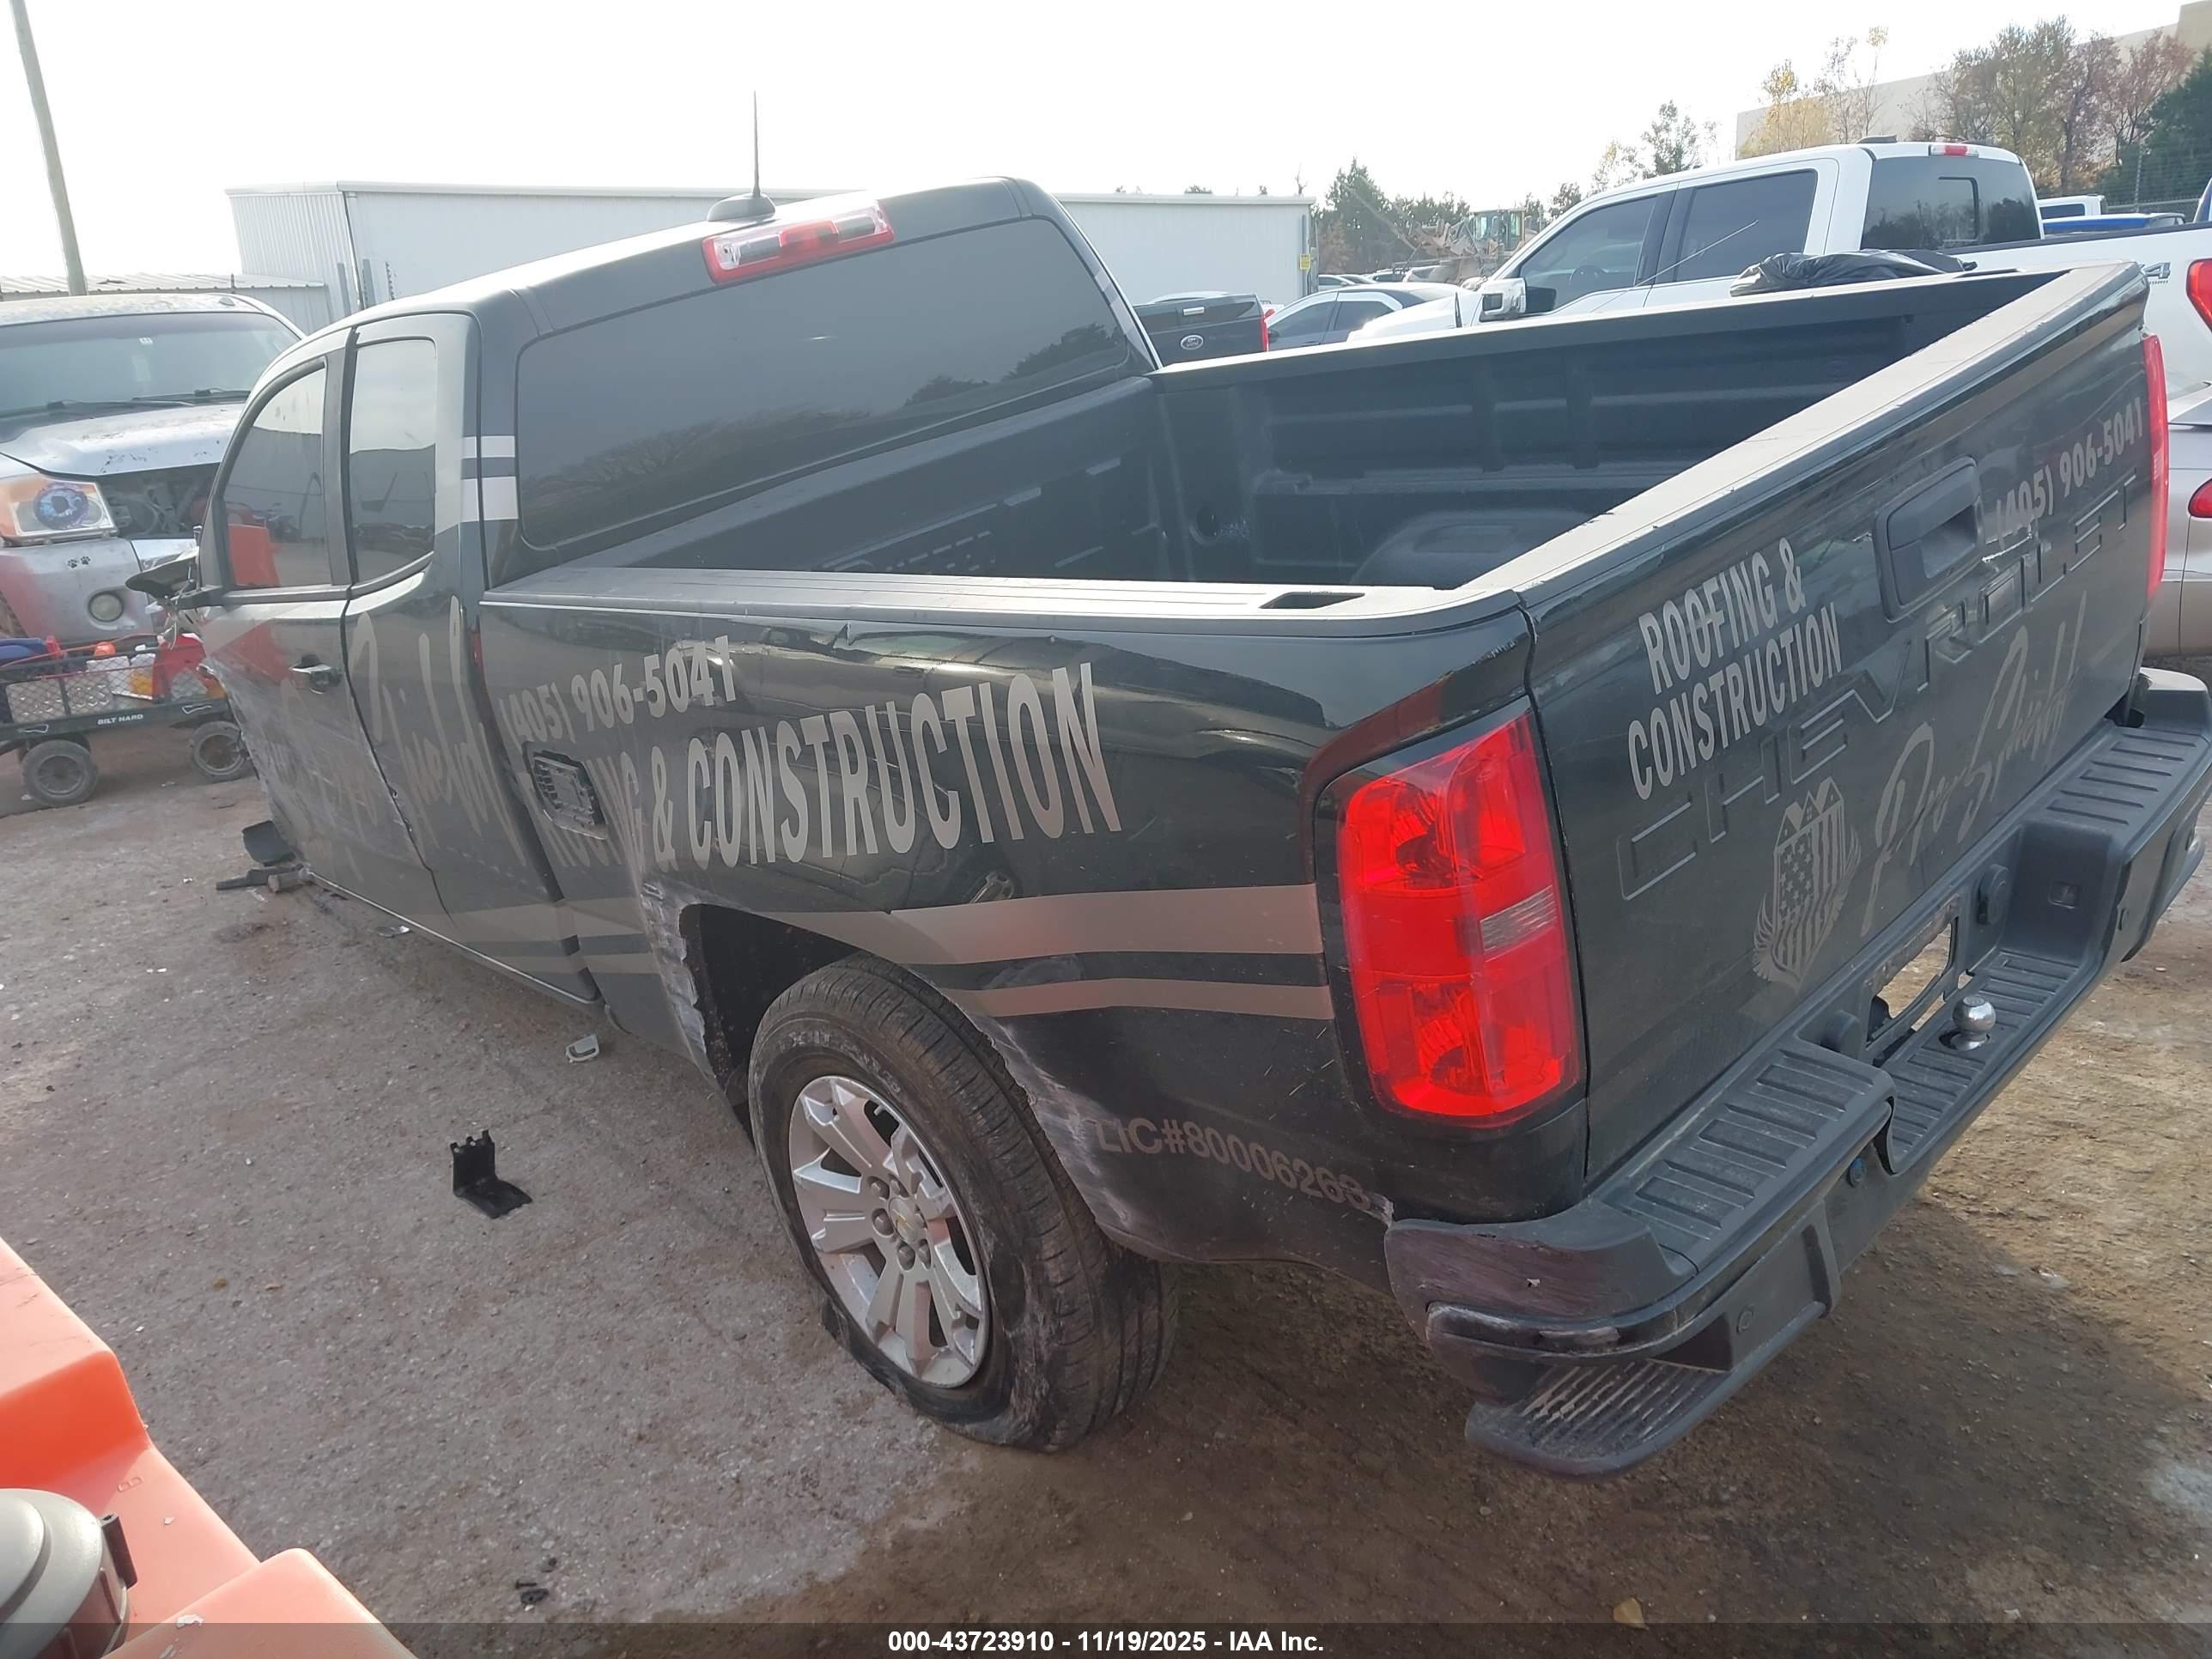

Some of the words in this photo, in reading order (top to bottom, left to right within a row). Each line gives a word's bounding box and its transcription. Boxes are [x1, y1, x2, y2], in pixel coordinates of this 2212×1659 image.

[2060, 397, 2142, 498] 906-5041
[498, 682, 576, 749] (405)
[570, 635, 736, 732] 906-5041
[1639, 551, 1778, 695] ROOFING
[1779, 538, 1808, 612] &
[651, 745, 678, 872] &
[688, 662, 1121, 869] CONSTRUCTION
[1628, 602, 1841, 799] CONSTRUCTION
